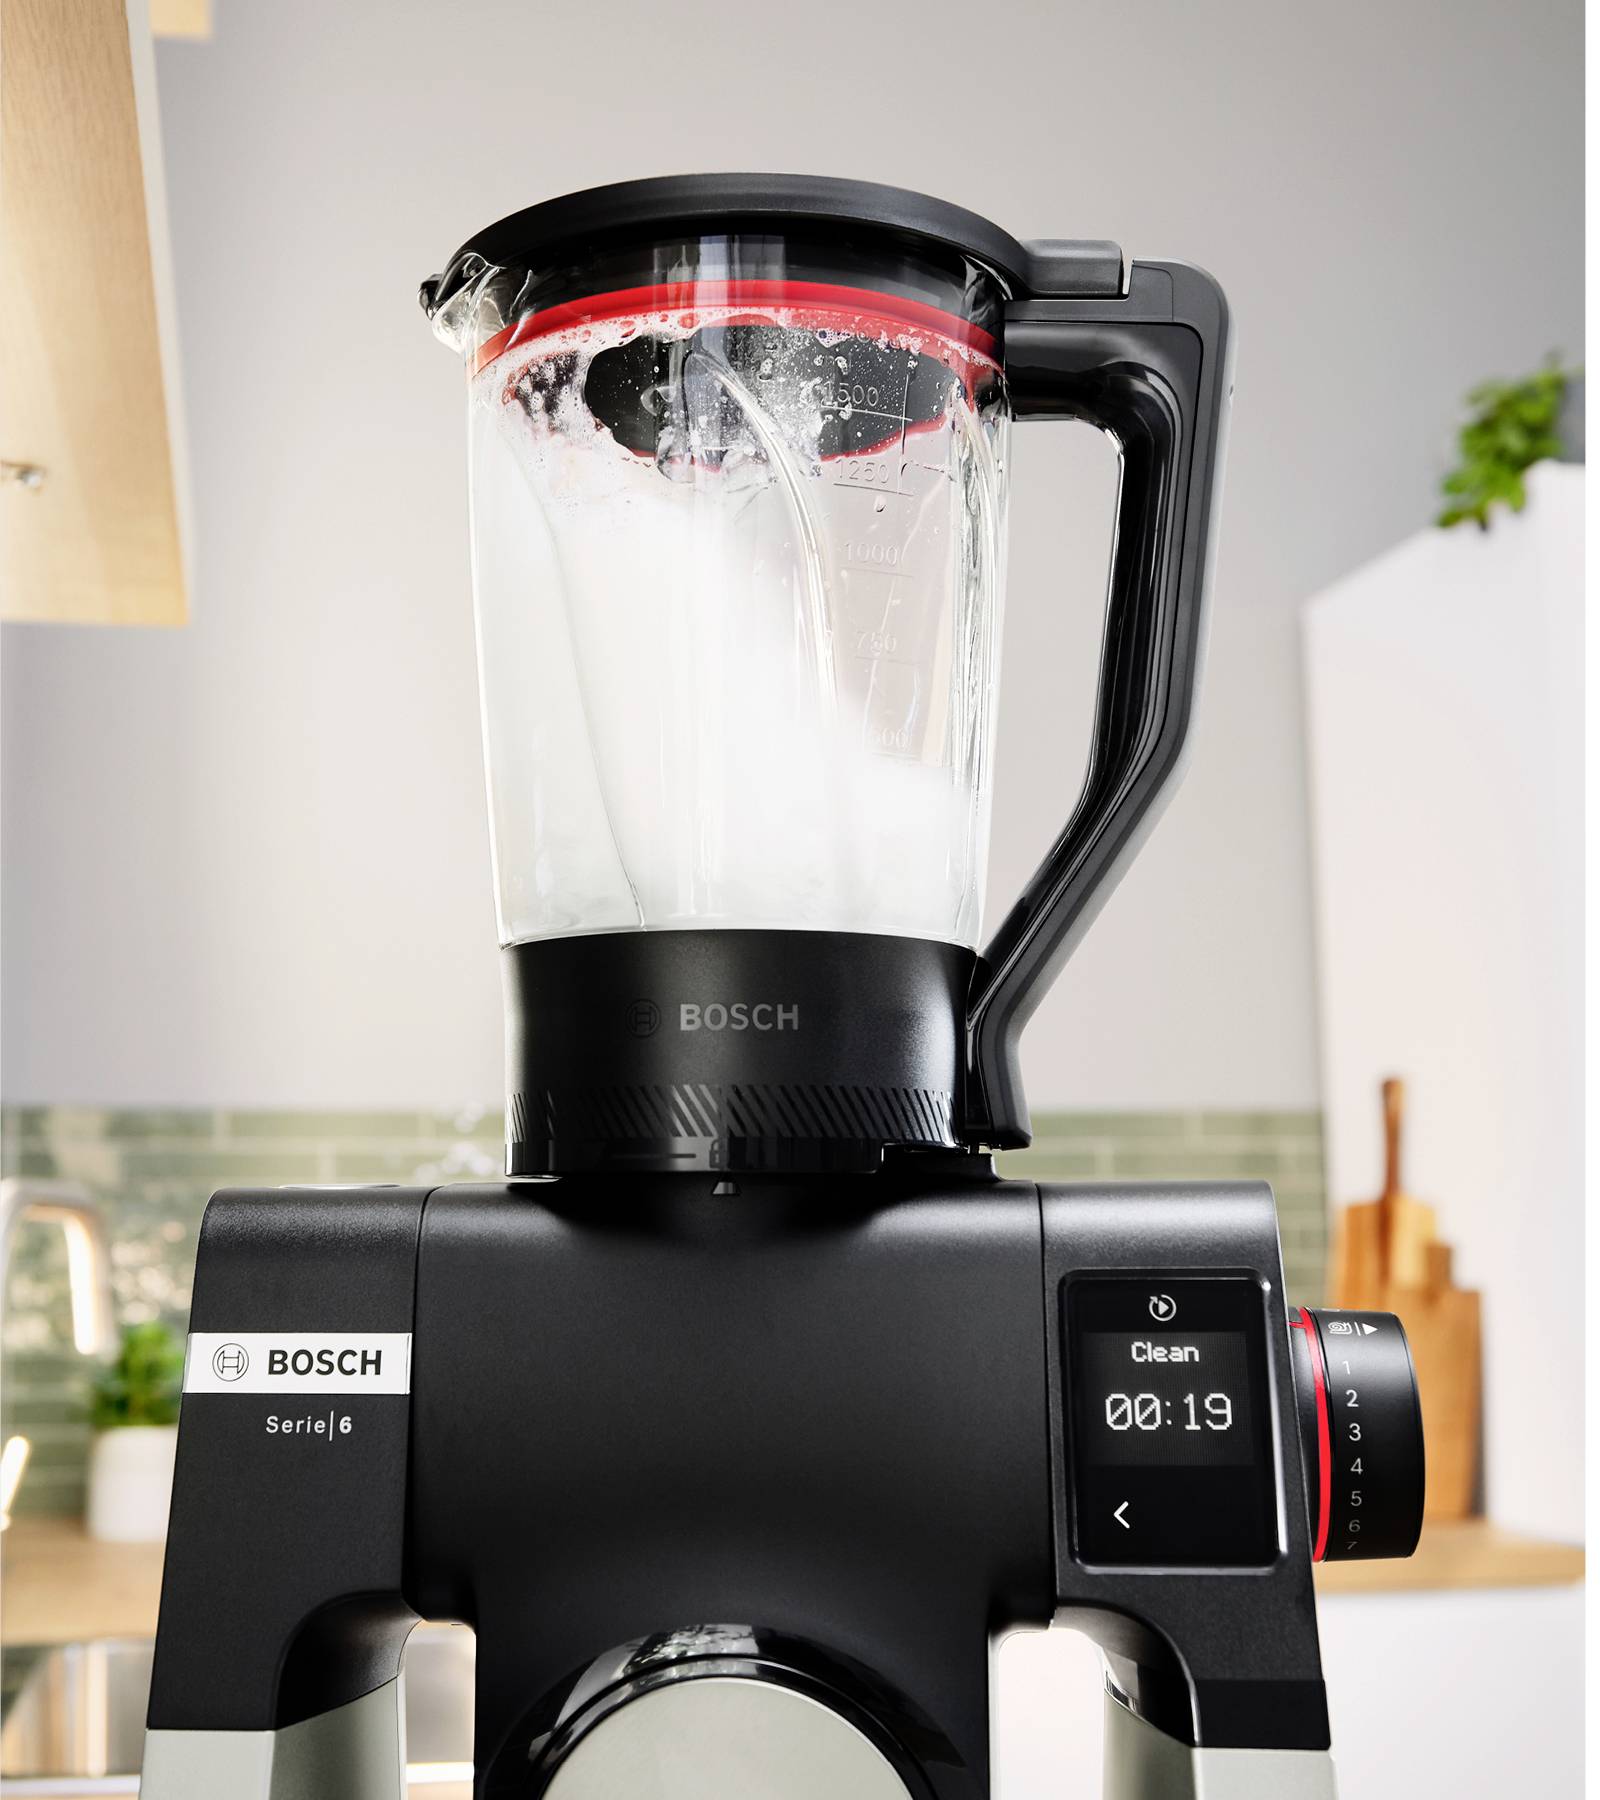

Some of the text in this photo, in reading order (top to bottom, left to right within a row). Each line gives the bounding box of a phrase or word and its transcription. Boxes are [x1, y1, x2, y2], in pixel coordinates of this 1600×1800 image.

[835, 460, 889, 483] 1250
[844, 541, 898, 566] 1000
[679, 1003, 799, 1031] BOSCH
[1130, 1341, 1200, 1363] Clean
[267, 1349, 382, 1376] BOSCH
[1342, 1361, 1351, 1375] 1
[1345, 1389, 1359, 1407] 2
[1105, 1393, 1233, 1431] 00:19
[1348, 1423, 1362, 1441] 3
[1350, 1457, 1364, 1475] 4
[1350, 1490, 1363, 1507] 5
[1348, 1519, 1361, 1533] 6
